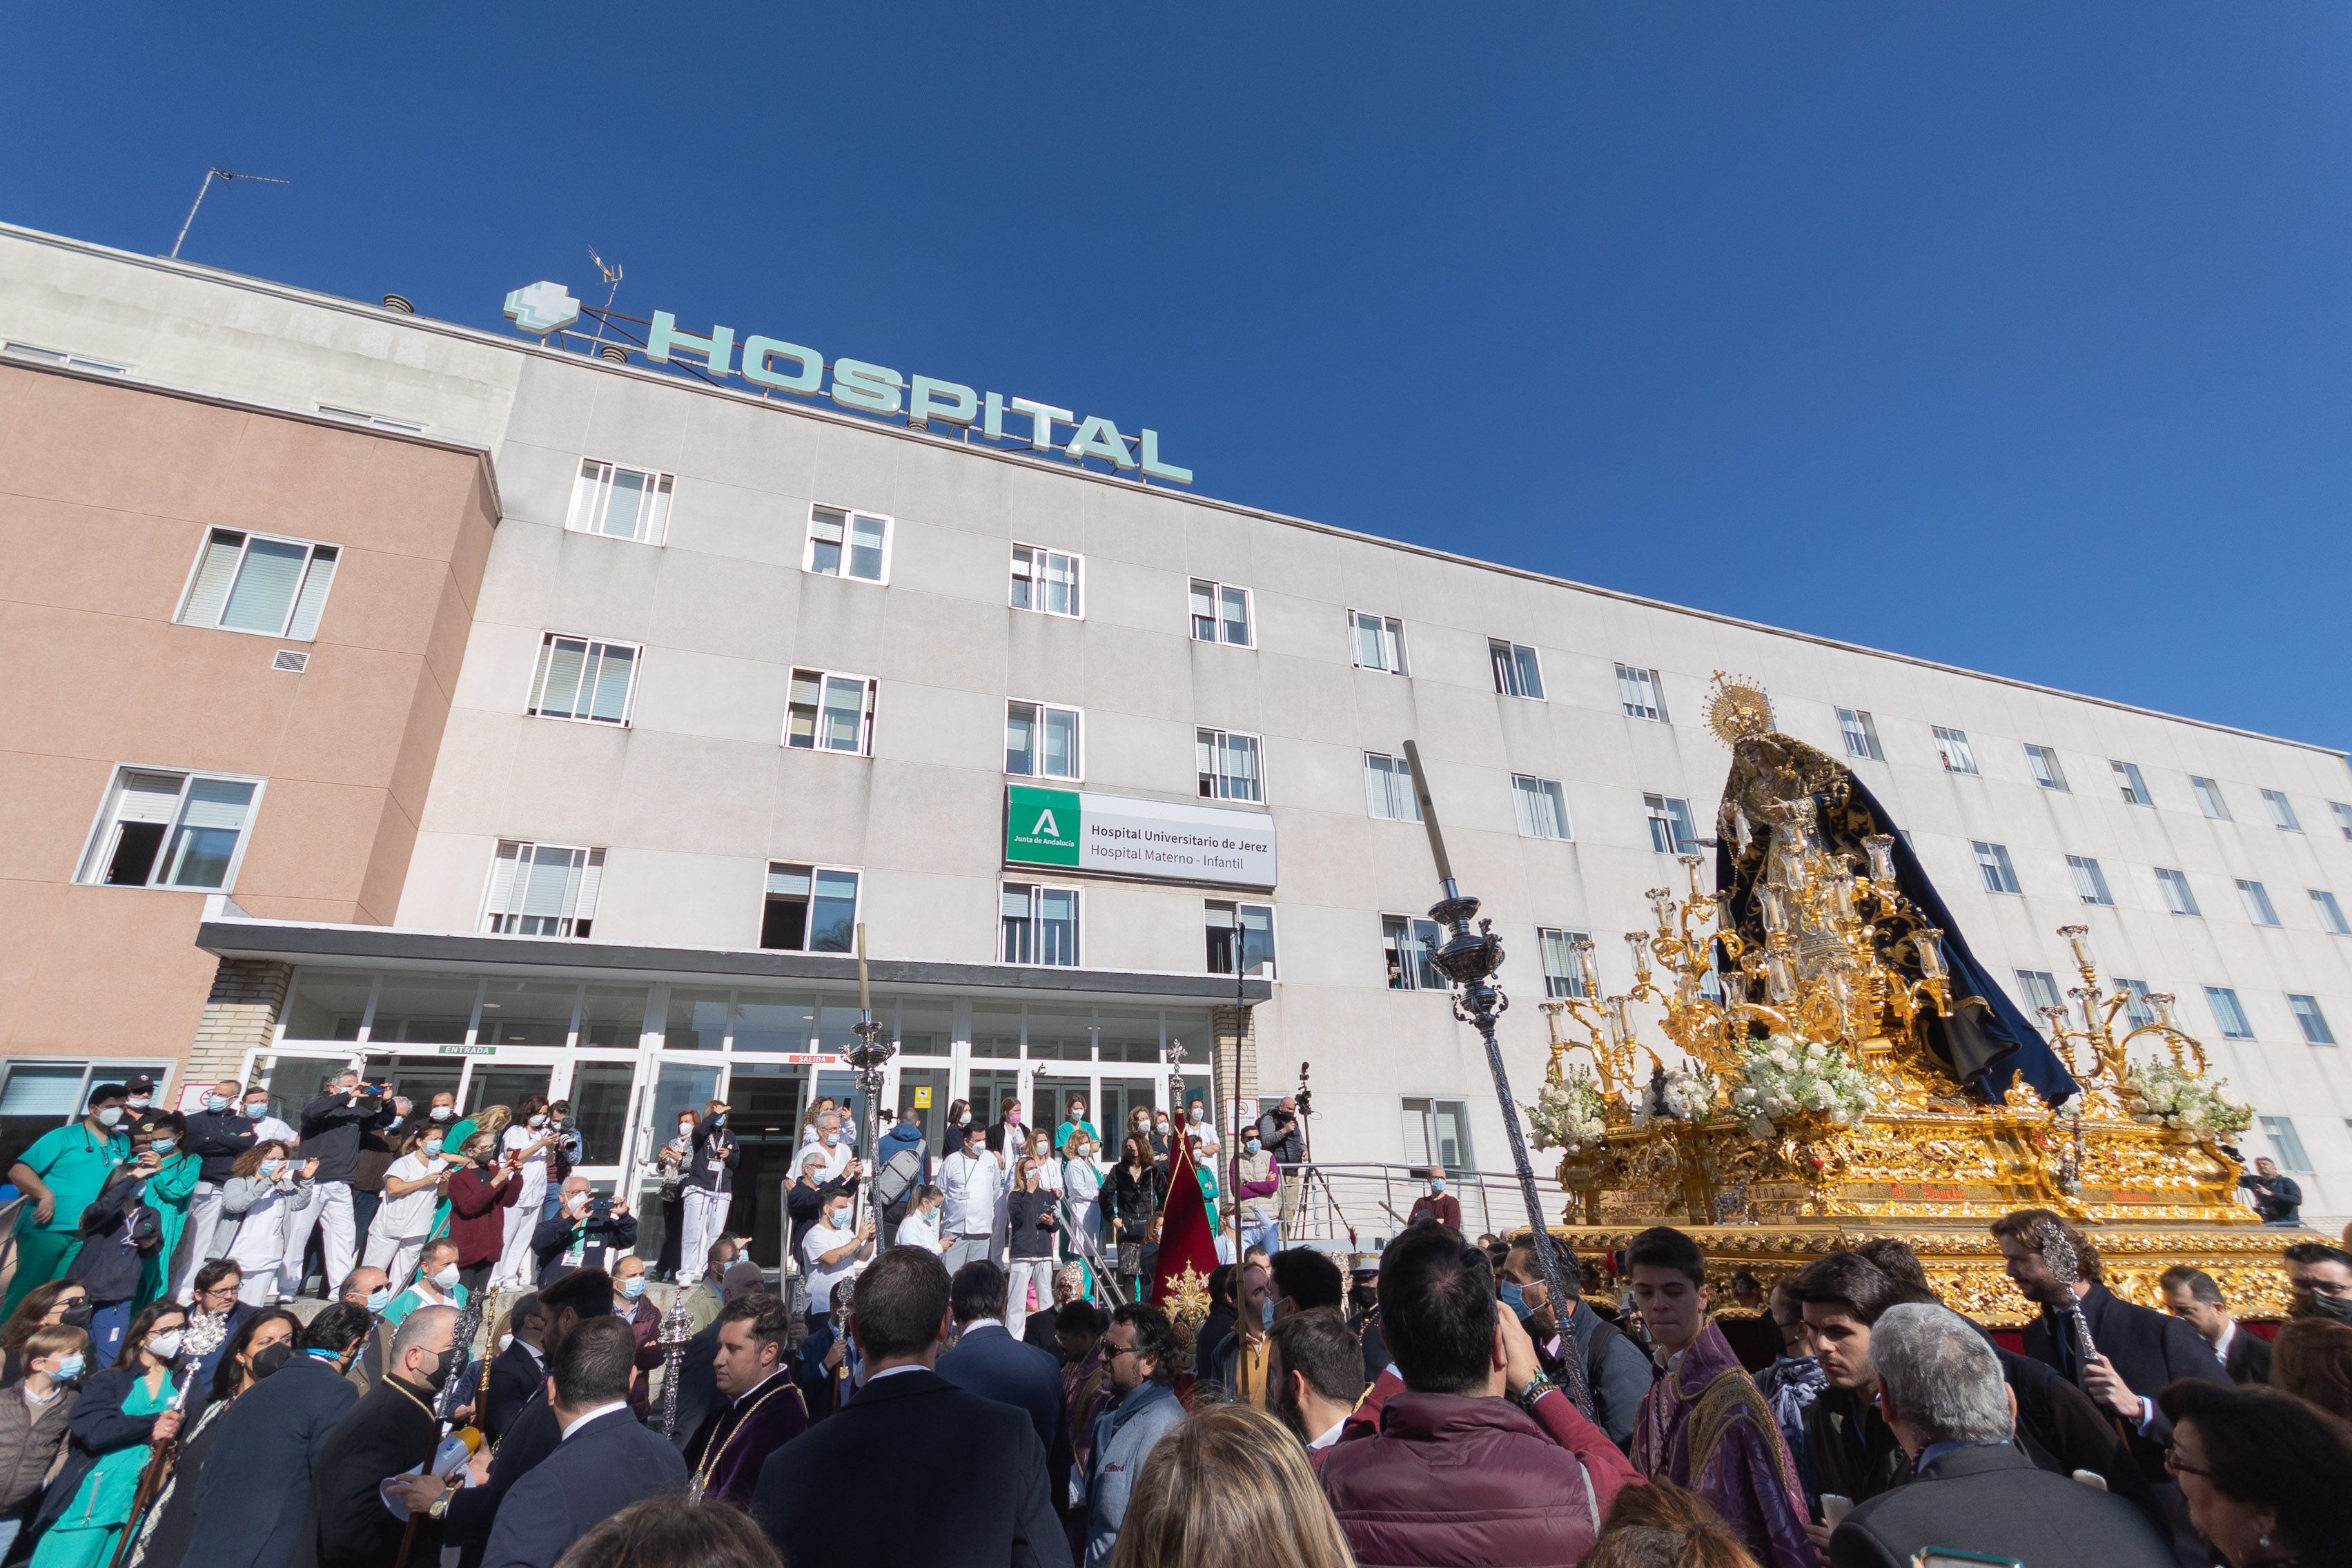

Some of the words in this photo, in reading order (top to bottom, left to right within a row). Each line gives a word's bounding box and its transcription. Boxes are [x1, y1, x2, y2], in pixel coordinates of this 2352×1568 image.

[646, 309, 1193, 484] HOSPITAL
[1014, 835, 1033, 843] Junta
[1043, 838, 1075, 847] Andalucía
[1092, 825, 1141, 840] Hospital
[1145, 830, 1219, 847] Universitario
[1222, 838, 1235, 849] de
[1238, 840, 1268, 852] Jerez
[1090, 844, 1141, 861] Hospital
[1145, 850, 1193, 864] Materno
[1204, 855, 1243, 870] Infantil
[444, 1046, 489, 1055] ENTRADA
